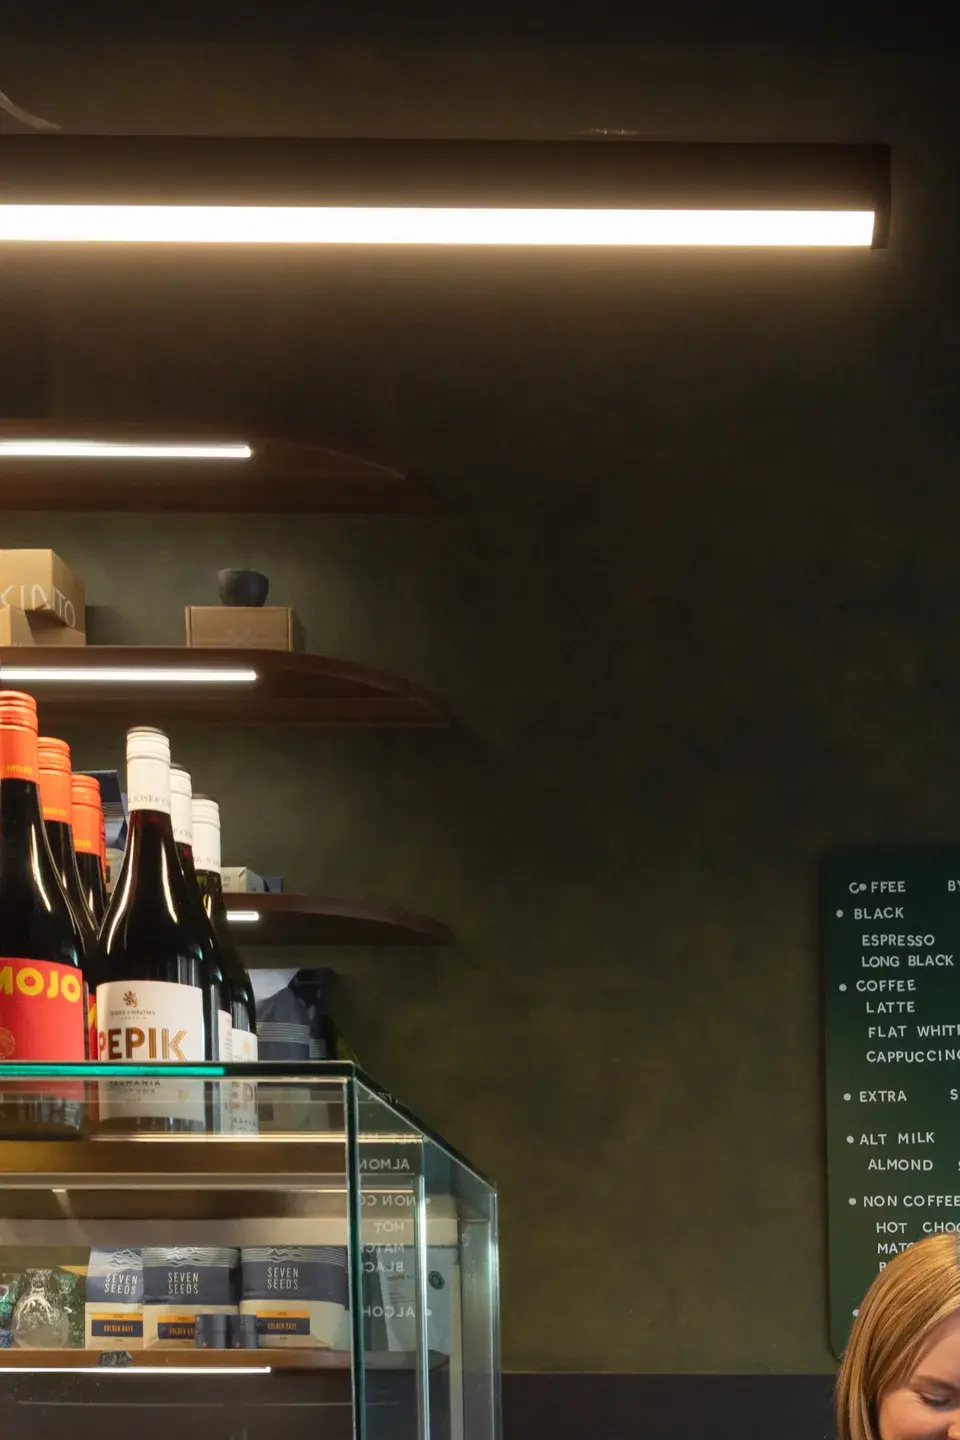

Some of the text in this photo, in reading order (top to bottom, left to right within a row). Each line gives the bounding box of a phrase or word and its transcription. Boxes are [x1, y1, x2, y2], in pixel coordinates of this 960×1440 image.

[854, 906, 905, 920] BLACK
[861, 933, 935, 948] ESPRESSO
[861, 955, 900, 969] LONG
[907, 953, 954, 967] BLACK
[855, 979, 917, 992] COFFEE
[866, 1001, 916, 1014] LATTE
[868, 1025, 907, 1039] FLAT
[99, 1027, 187, 1063] PEPIK
[859, 1089, 908, 1103] EXTRA
[859, 1131, 935, 1146] ALT MILK
[867, 1158, 934, 1171] ALMOND
[863, 1195, 898, 1208] NON
[876, 1221, 908, 1234] HOT
[105, 1273, 138, 1285] SEVEN
[168, 1271, 199, 1283] SEVEN
[267, 1266, 299, 1279] SEVEN
[104, 1283, 137, 1295] SEEDS
[168, 1283, 199, 1295] SEEDS
[267, 1278, 299, 1291] SEEDS
